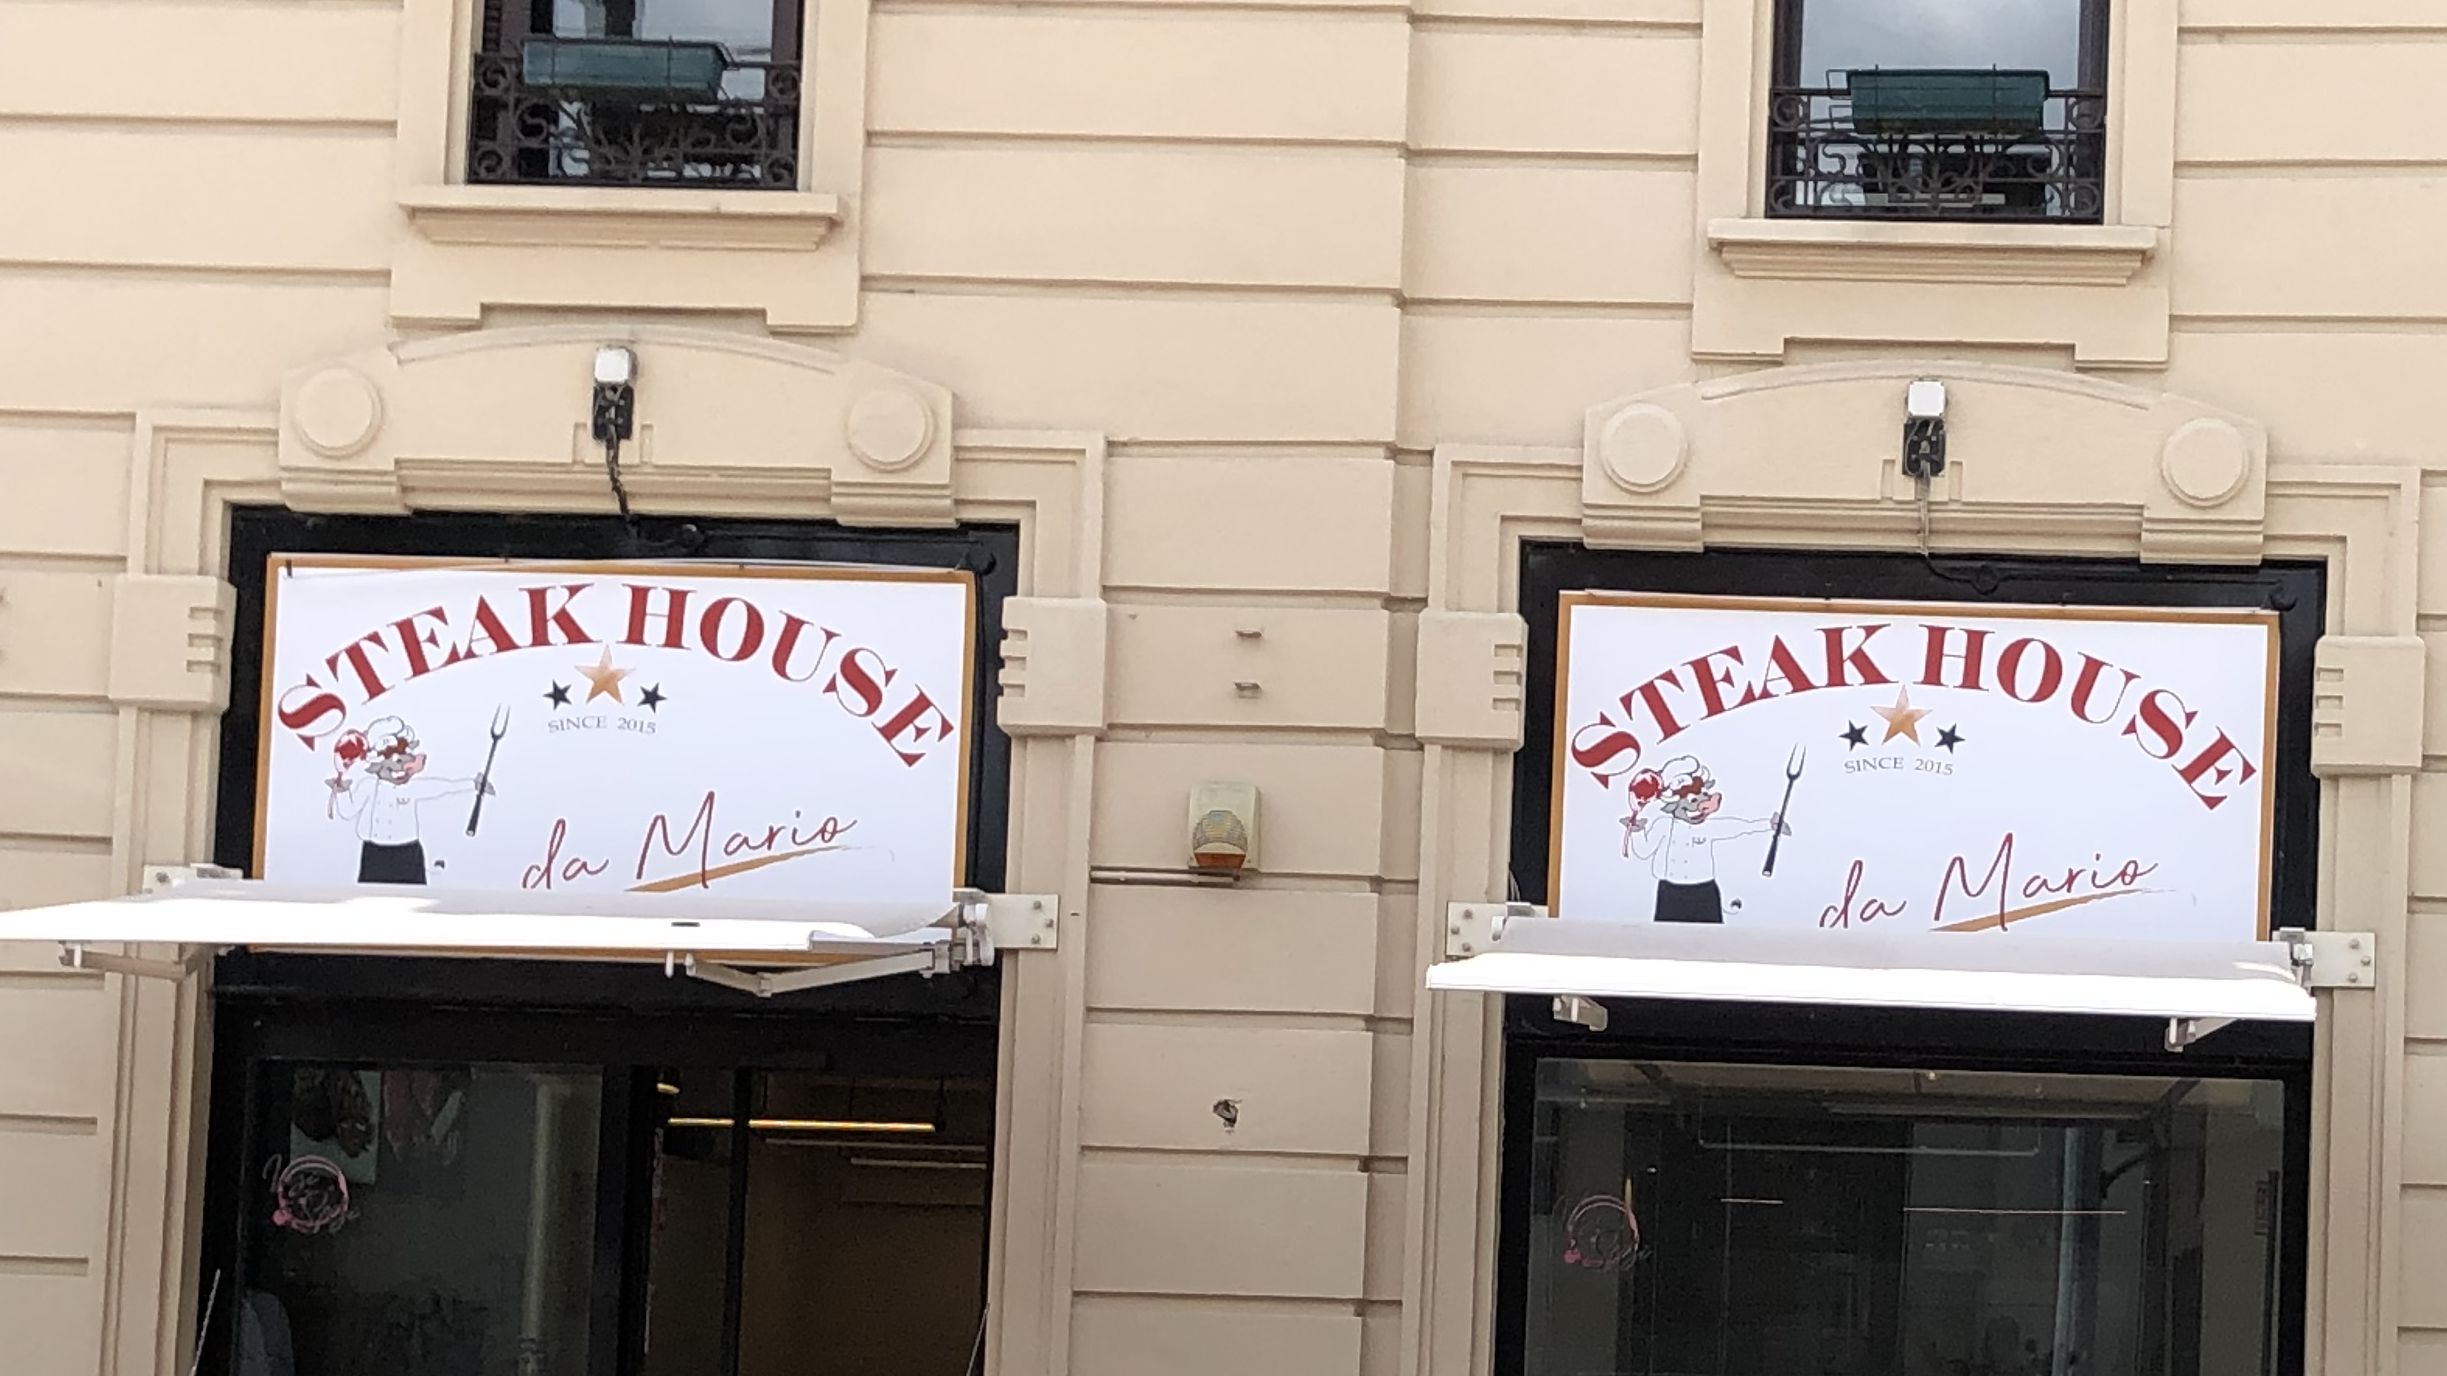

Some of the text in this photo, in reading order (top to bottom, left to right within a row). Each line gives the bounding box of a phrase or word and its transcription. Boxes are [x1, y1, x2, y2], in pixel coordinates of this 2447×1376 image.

[278, 583, 954, 768] STEAK HOUSE
[547, 716, 656, 734] SINCE 2015
[1570, 624, 2257, 811] STEAK HOUSE
[1844, 757, 1953, 776] SINCE 2015
[521, 790, 858, 890] da Mario
[1818, 833, 2160, 931] da Mario
